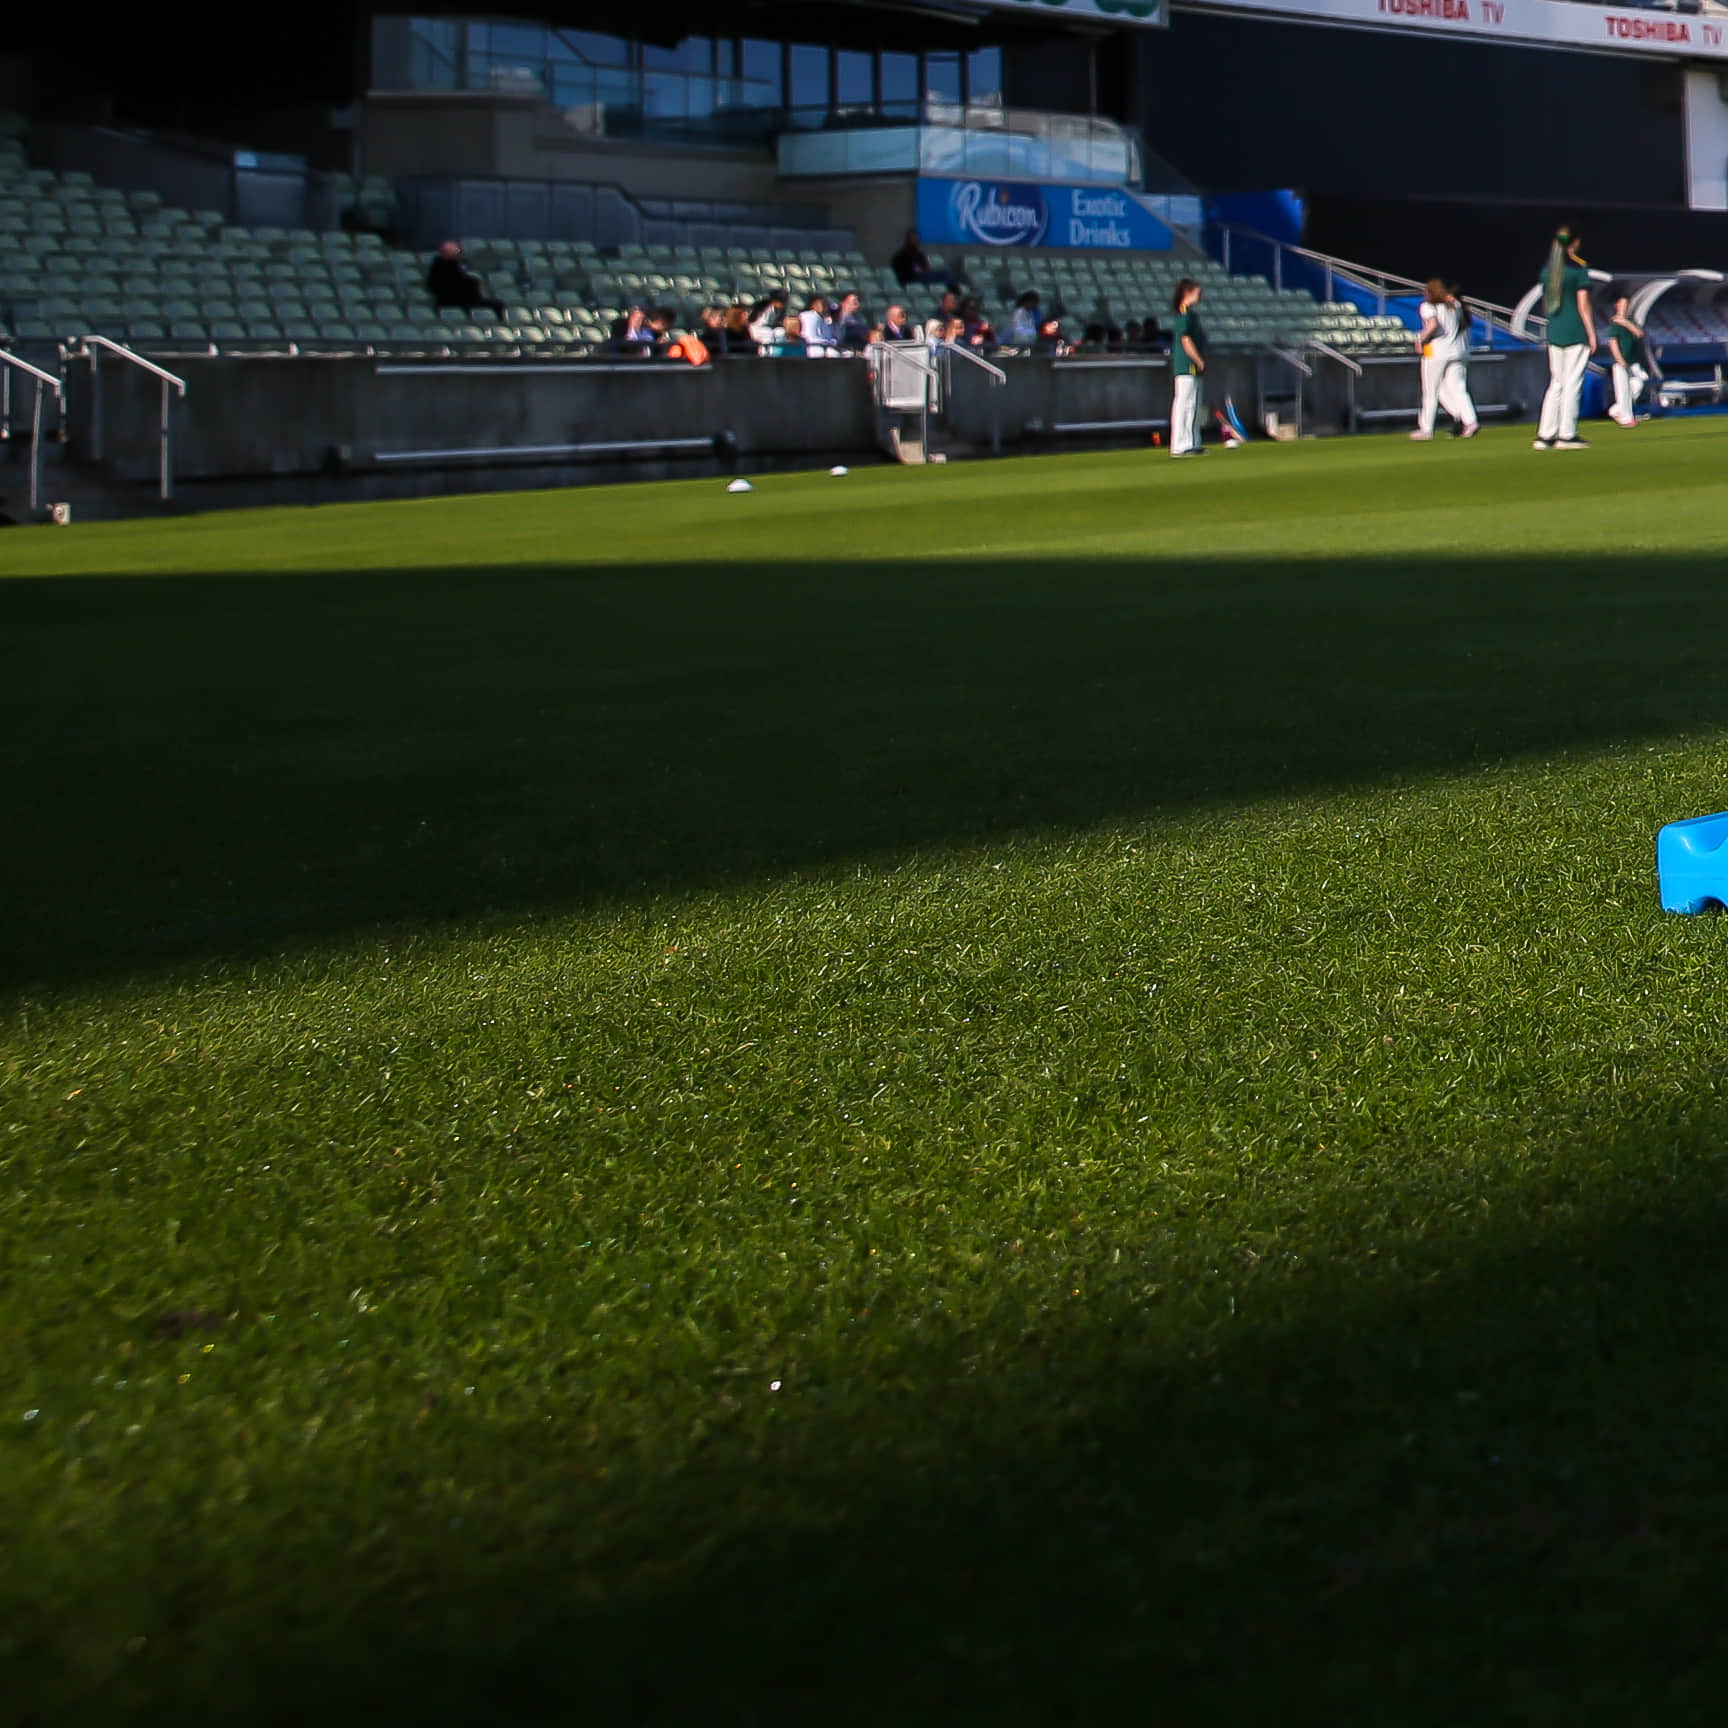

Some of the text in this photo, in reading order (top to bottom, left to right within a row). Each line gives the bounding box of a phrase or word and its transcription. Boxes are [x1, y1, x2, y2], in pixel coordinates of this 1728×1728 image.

[1482, 1, 1505, 25] TV
[1605, 16, 1723, 45] TOSHIBA TV
[957, 182, 1039, 244] Rubicon
[1071, 189, 1126, 217] Exotic
[1069, 219, 1131, 248] Drinks
